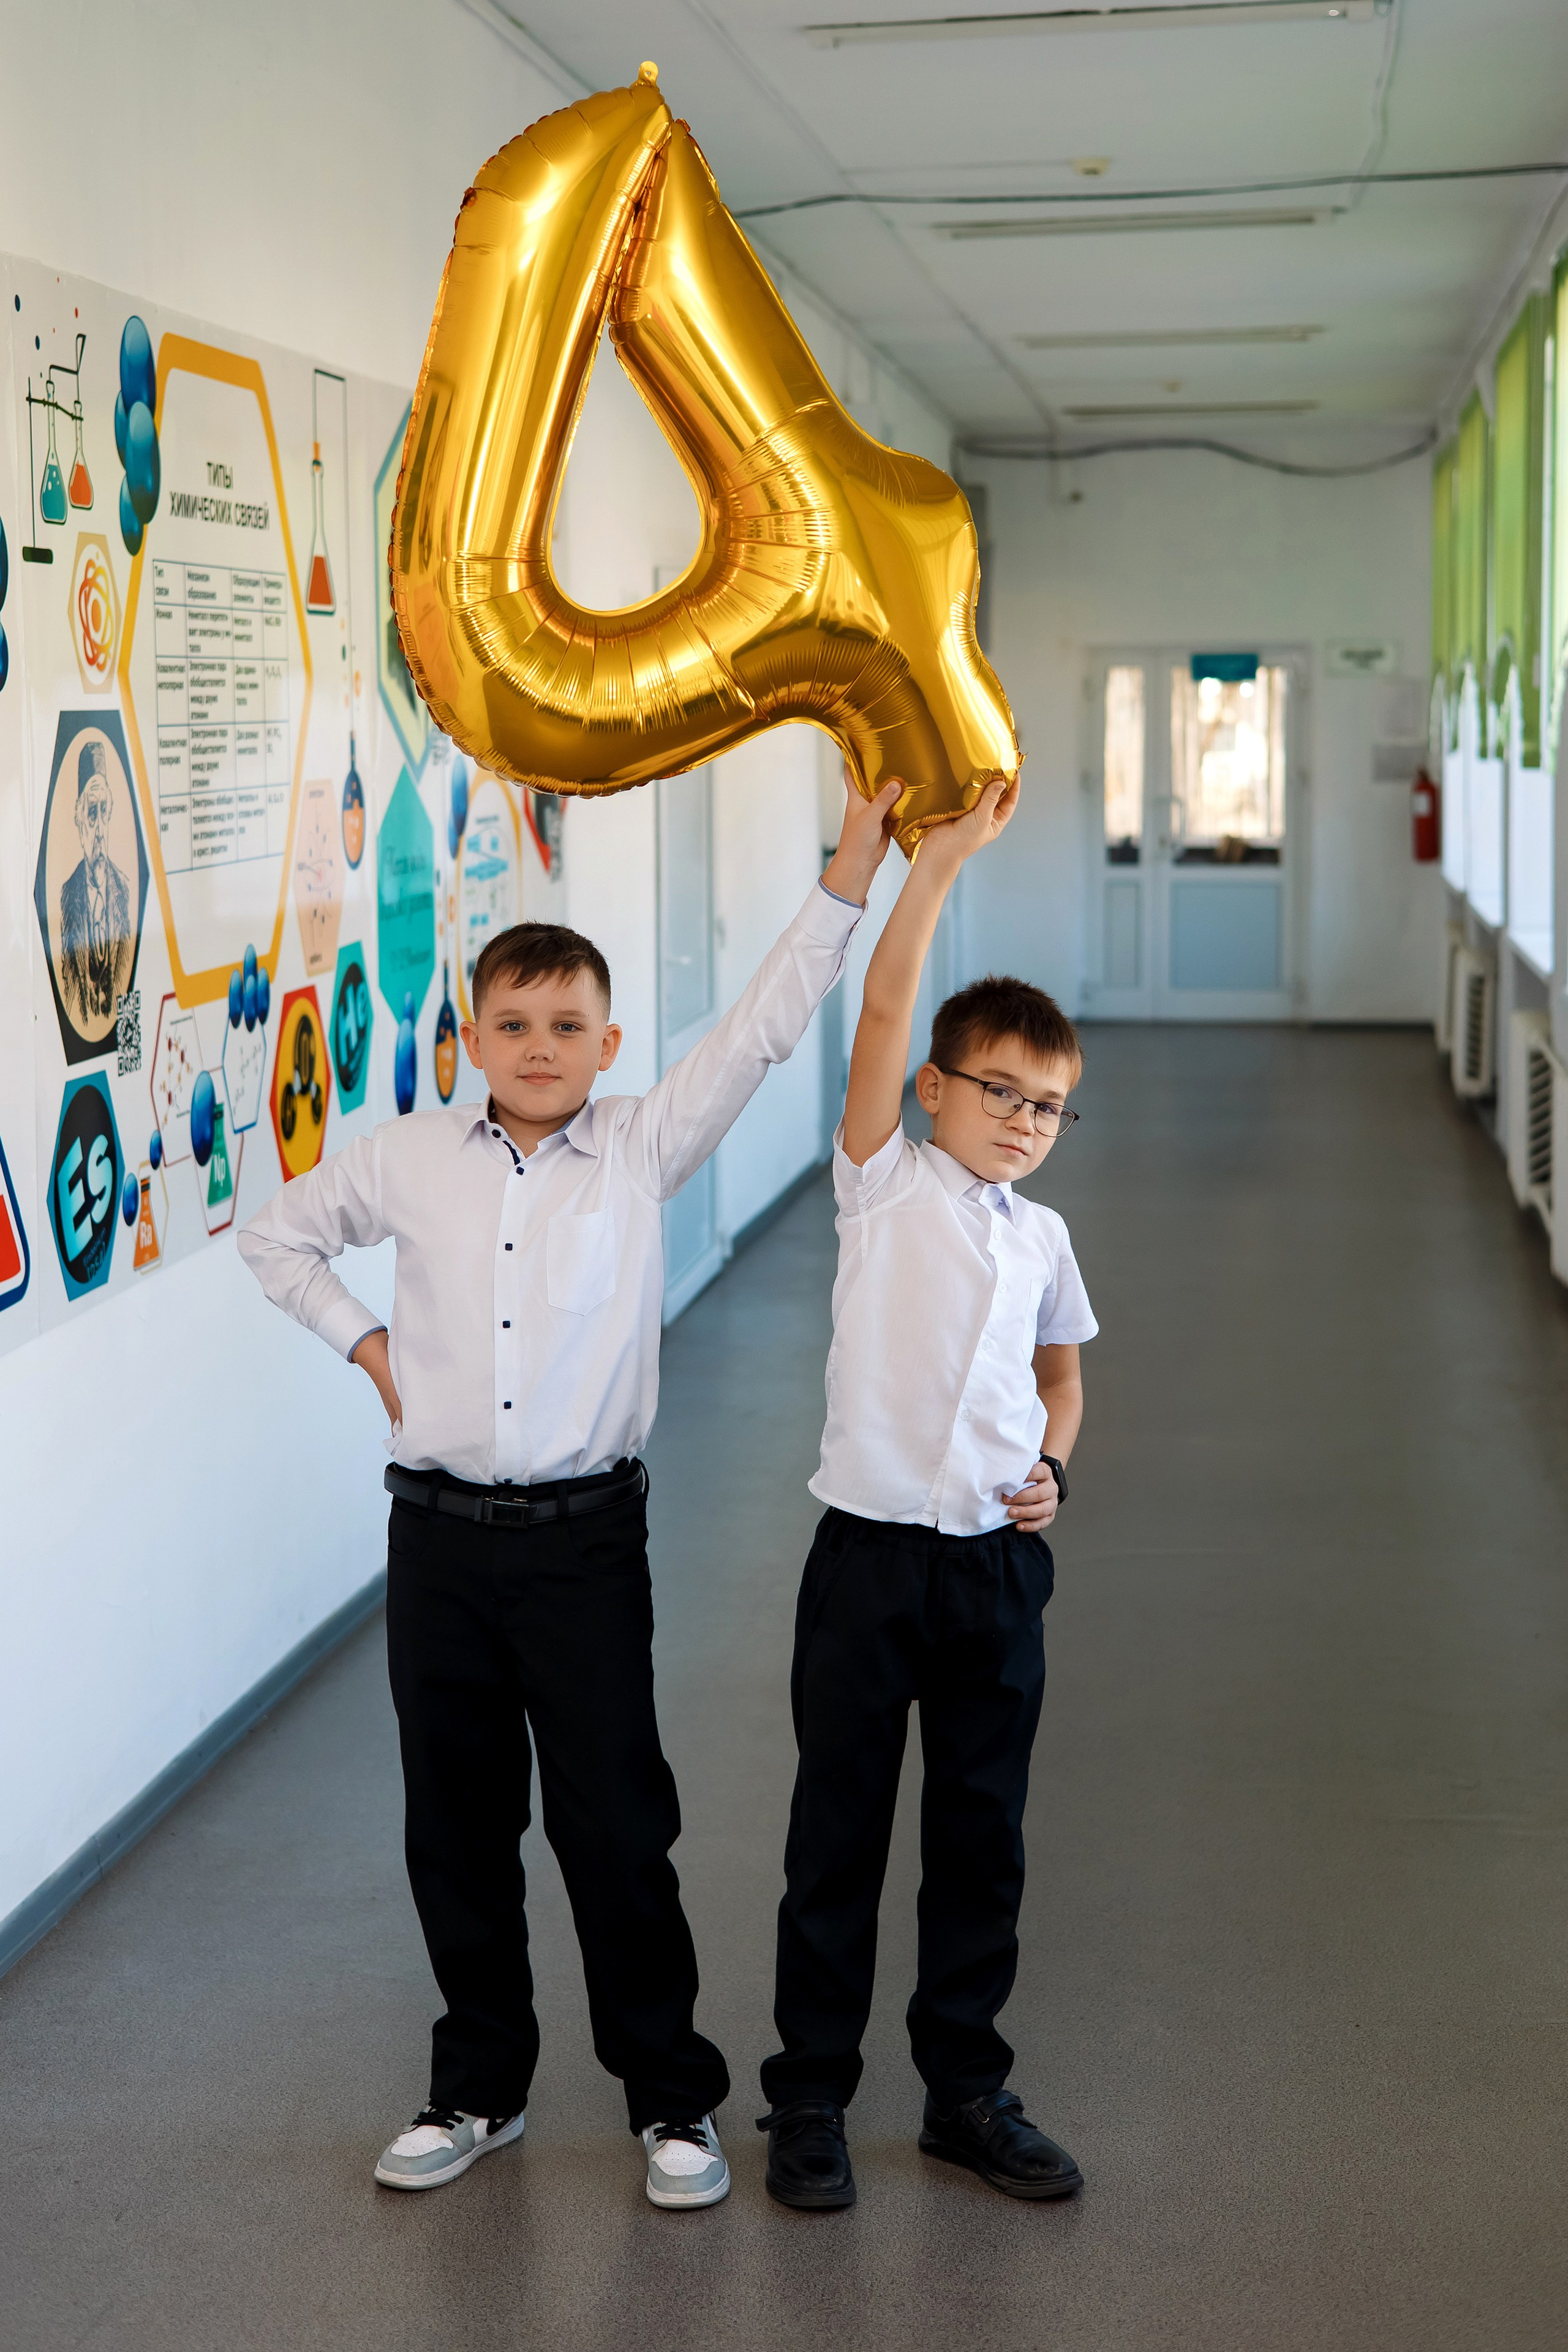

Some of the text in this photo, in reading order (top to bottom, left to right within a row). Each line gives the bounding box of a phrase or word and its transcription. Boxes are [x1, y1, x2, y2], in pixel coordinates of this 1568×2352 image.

[207, 462, 233, 489] ТИПЫ
[170, 491, 270, 530] ХИМИЧЕСКИХ СВЯЗЕЙ
[214, 1153, 225, 1186] Np
[140, 1221, 153, 1248] Ra
